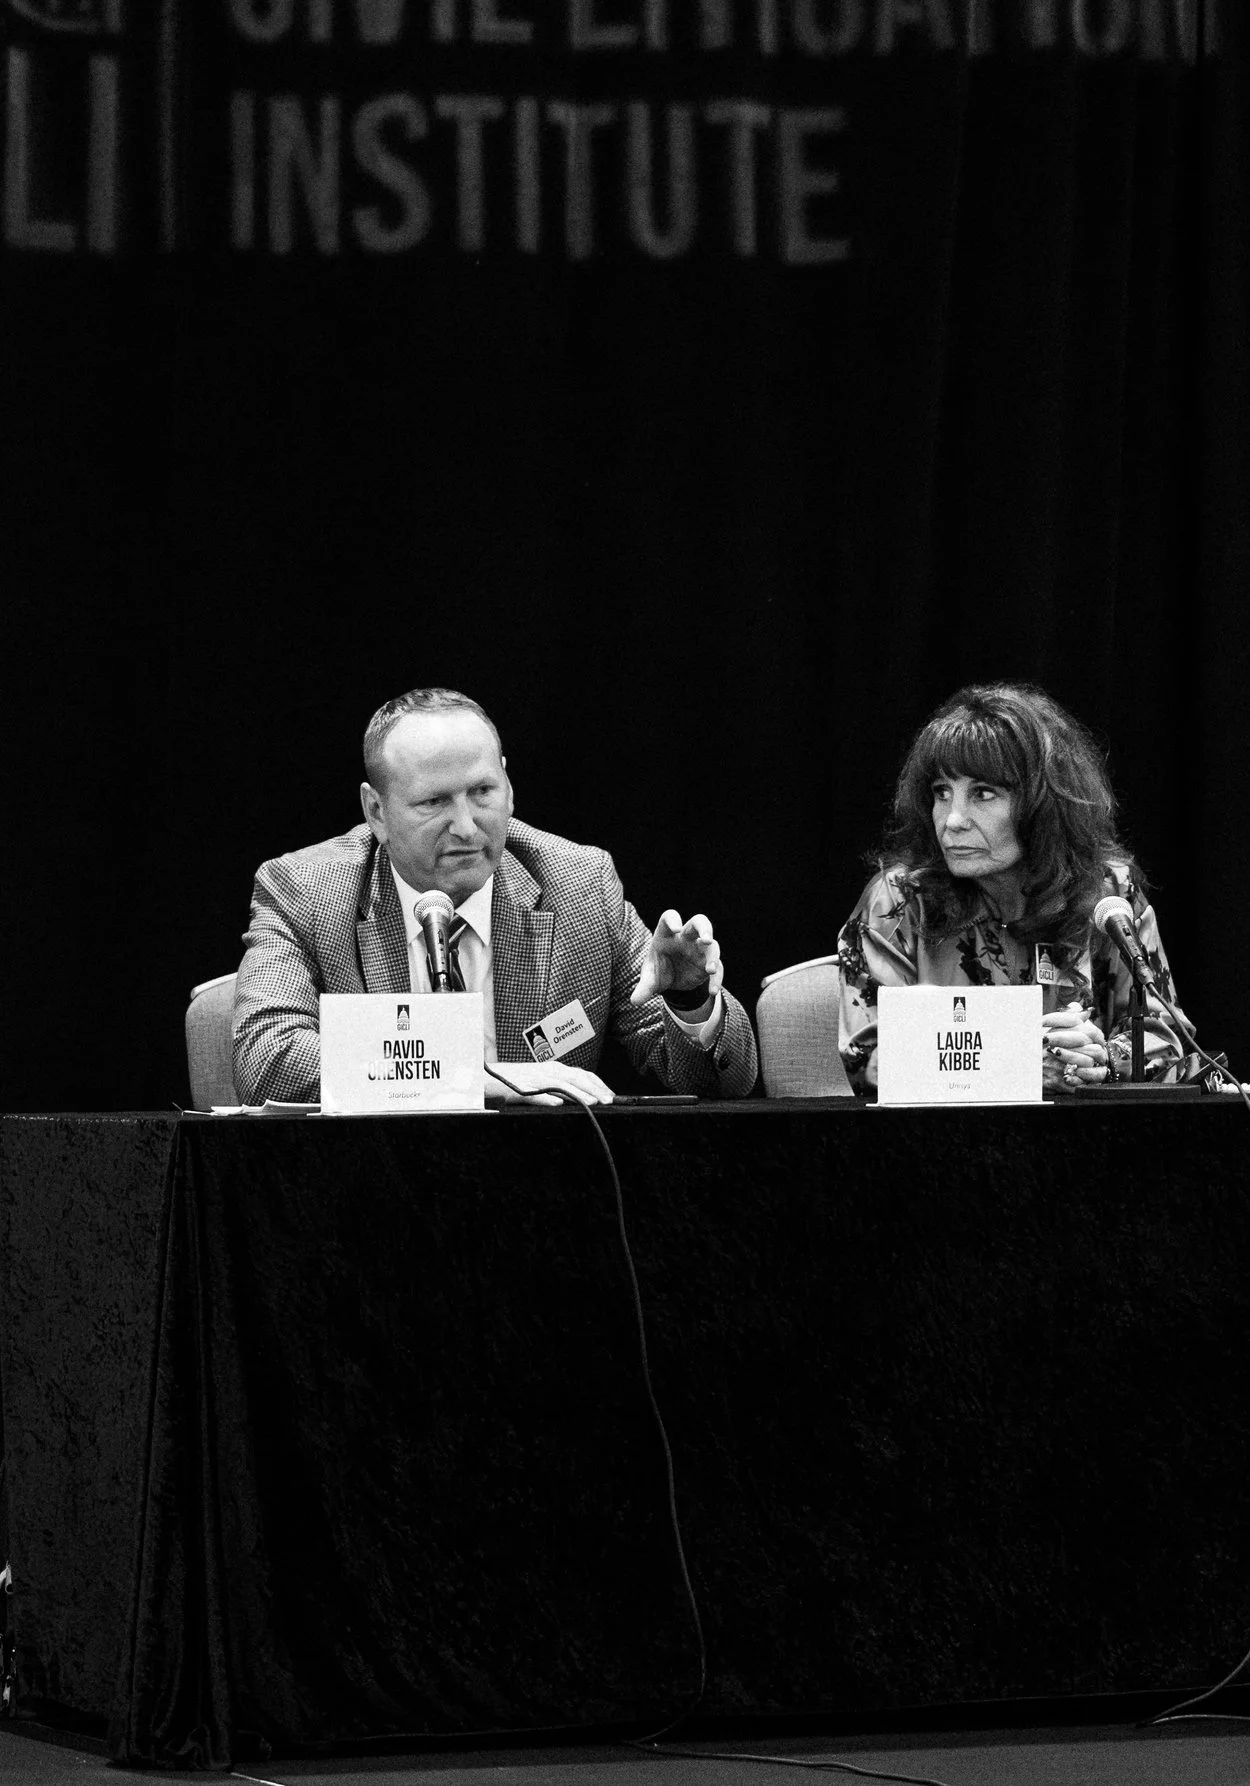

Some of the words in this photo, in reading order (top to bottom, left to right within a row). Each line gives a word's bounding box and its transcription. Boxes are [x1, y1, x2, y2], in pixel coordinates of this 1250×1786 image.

[228, 90, 851, 264] INSTITUTE
[396, 1023, 411, 1032] GICLI
[553, 1023, 585, 1045] Orensten
[554, 1018, 576, 1034] David
[383, 1039, 425, 1059] DAVID
[937, 1031, 983, 1051] LAURA
[536, 1047, 556, 1064] GICLI
[939, 1052, 981, 1072] KIBBE
[368, 1060, 441, 1081] OENSTEN
